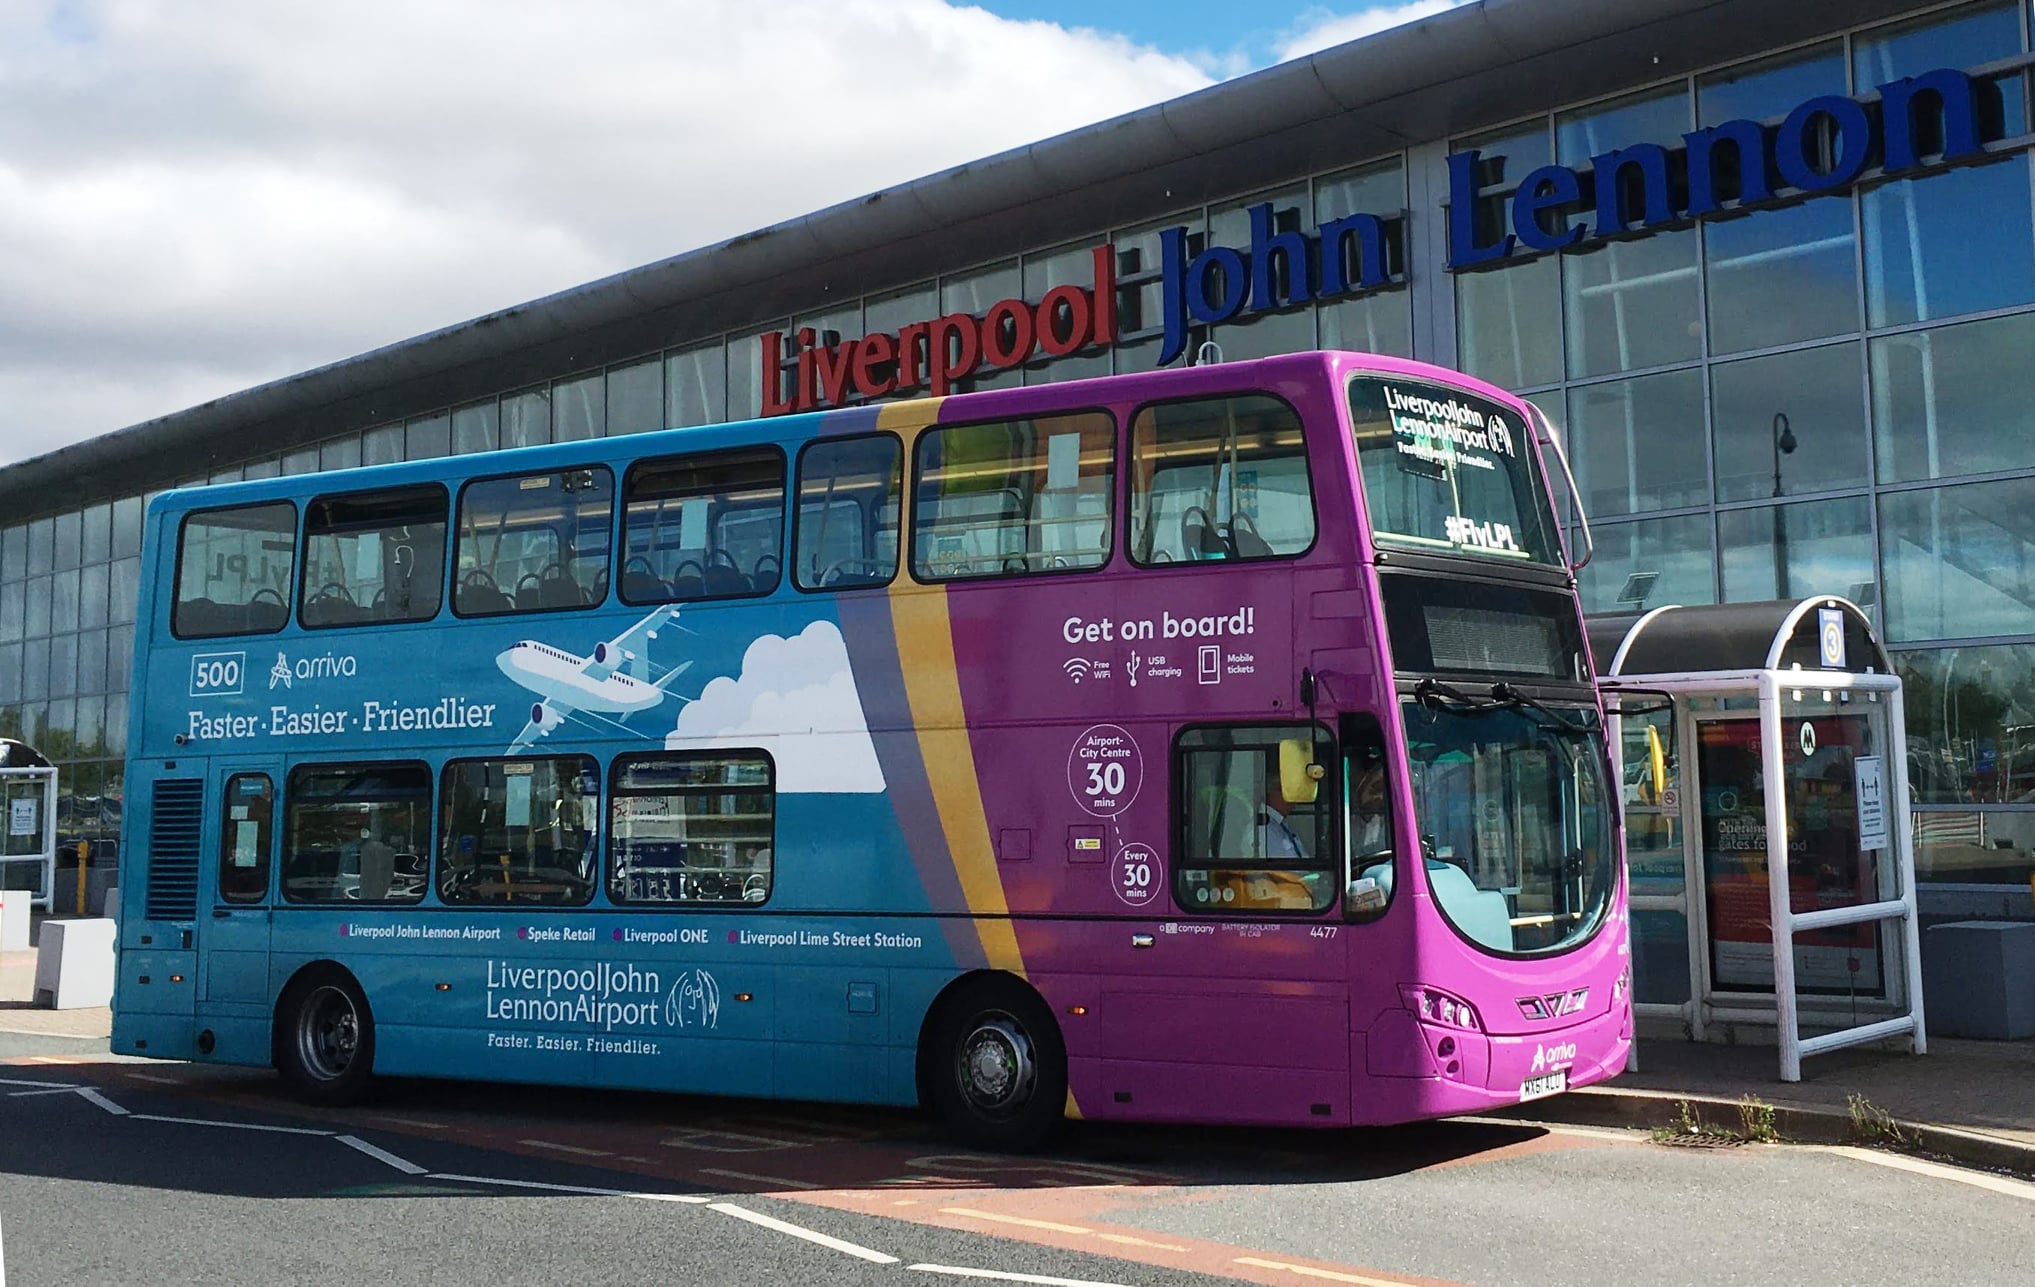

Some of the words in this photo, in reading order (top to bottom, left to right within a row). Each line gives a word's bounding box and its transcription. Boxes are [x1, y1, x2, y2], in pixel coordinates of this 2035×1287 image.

[760, 244, 1116, 417] Liverpool
[1158, 202, 1390, 367] John
[1446, 67, 1985, 268] Lennon
[1384, 386, 1484, 427] LiverpoolJohn
[1444, 515, 1519, 551] #FlyLPL
[1063, 616, 1114, 644] Get
[1120, 618, 1154, 640] on
[1163, 607, 1254, 639] board!
[1828, 629, 1838, 657] 3
[1093, 661, 1110, 669] Free
[1148, 656, 1166, 666] USB
[1227, 654, 1254, 663] Mobile
[196, 661, 238, 688] 500
[296, 652, 357, 679] arriva
[1148, 667, 1182, 678] charging
[1227, 665, 1255, 674] tickets
[188, 711, 258, 740] Faster
[270, 704, 348, 736] Easier
[363, 697, 496, 732] Friendlier
[1087, 736, 1124, 747] Airport-
[1079, 748, 1099, 760] City
[1100, 748, 1131, 758] Centre
[1085, 762, 1126, 796] 30
[1094, 798, 1116, 808] mins
[1124, 851, 1149, 862] Every
[1123, 863, 1151, 887] 30
[1126, 888, 1147, 898] mins
[349, 923, 395, 938] Liverpool
[396, 925, 420, 939] John
[422, 926, 460, 939] Lennon
[462, 926, 500, 941] Airport
[528, 927, 561, 942] Speke
[563, 928, 596, 941] Retail
[624, 928, 678, 944] Liverpool
[680, 929, 709, 943] ONE
[1178, 924, 1215, 935] company
[1310, 926, 1337, 939] 4477
[740, 930, 797, 947] Liverpool
[800, 931, 830, 946] Lime
[832, 932, 871, 947] Street
[874, 933, 922, 948] Station
[487, 960, 659, 999] LiverpoolJohn
[487, 991, 659, 1032] LennonAirport
[488, 1033, 532, 1049] Faster.
[537, 1036, 582, 1051] Easier.
[587, 1038, 661, 1055] Friendlier.
[1546, 1041, 1576, 1063] arriva
